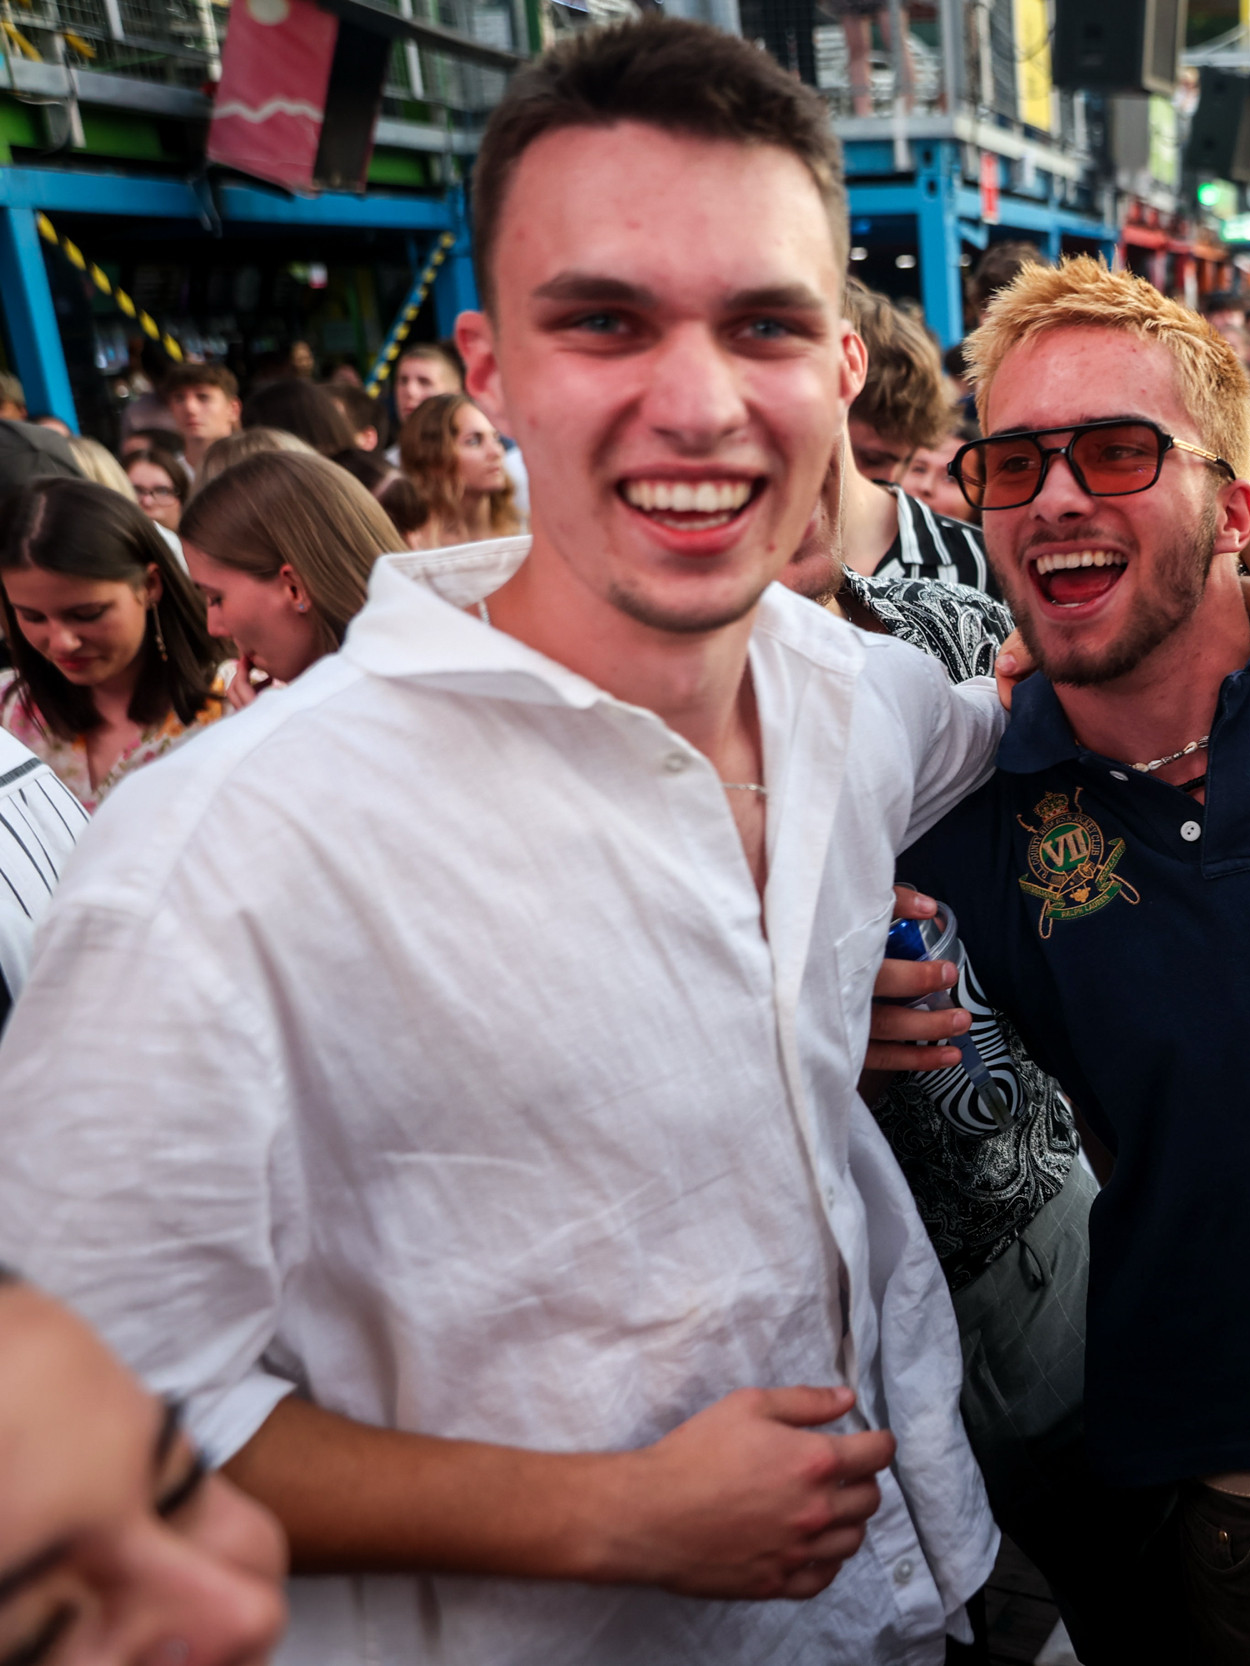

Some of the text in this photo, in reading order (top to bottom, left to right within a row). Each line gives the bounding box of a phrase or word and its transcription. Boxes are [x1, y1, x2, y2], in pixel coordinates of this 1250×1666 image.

[1030, 835, 1042, 865] COUNTY
[1091, 834, 1101, 856] CLUB
[1042, 827, 1089, 867] VII
[1061, 893, 1110, 918] RALPH LAUREN
